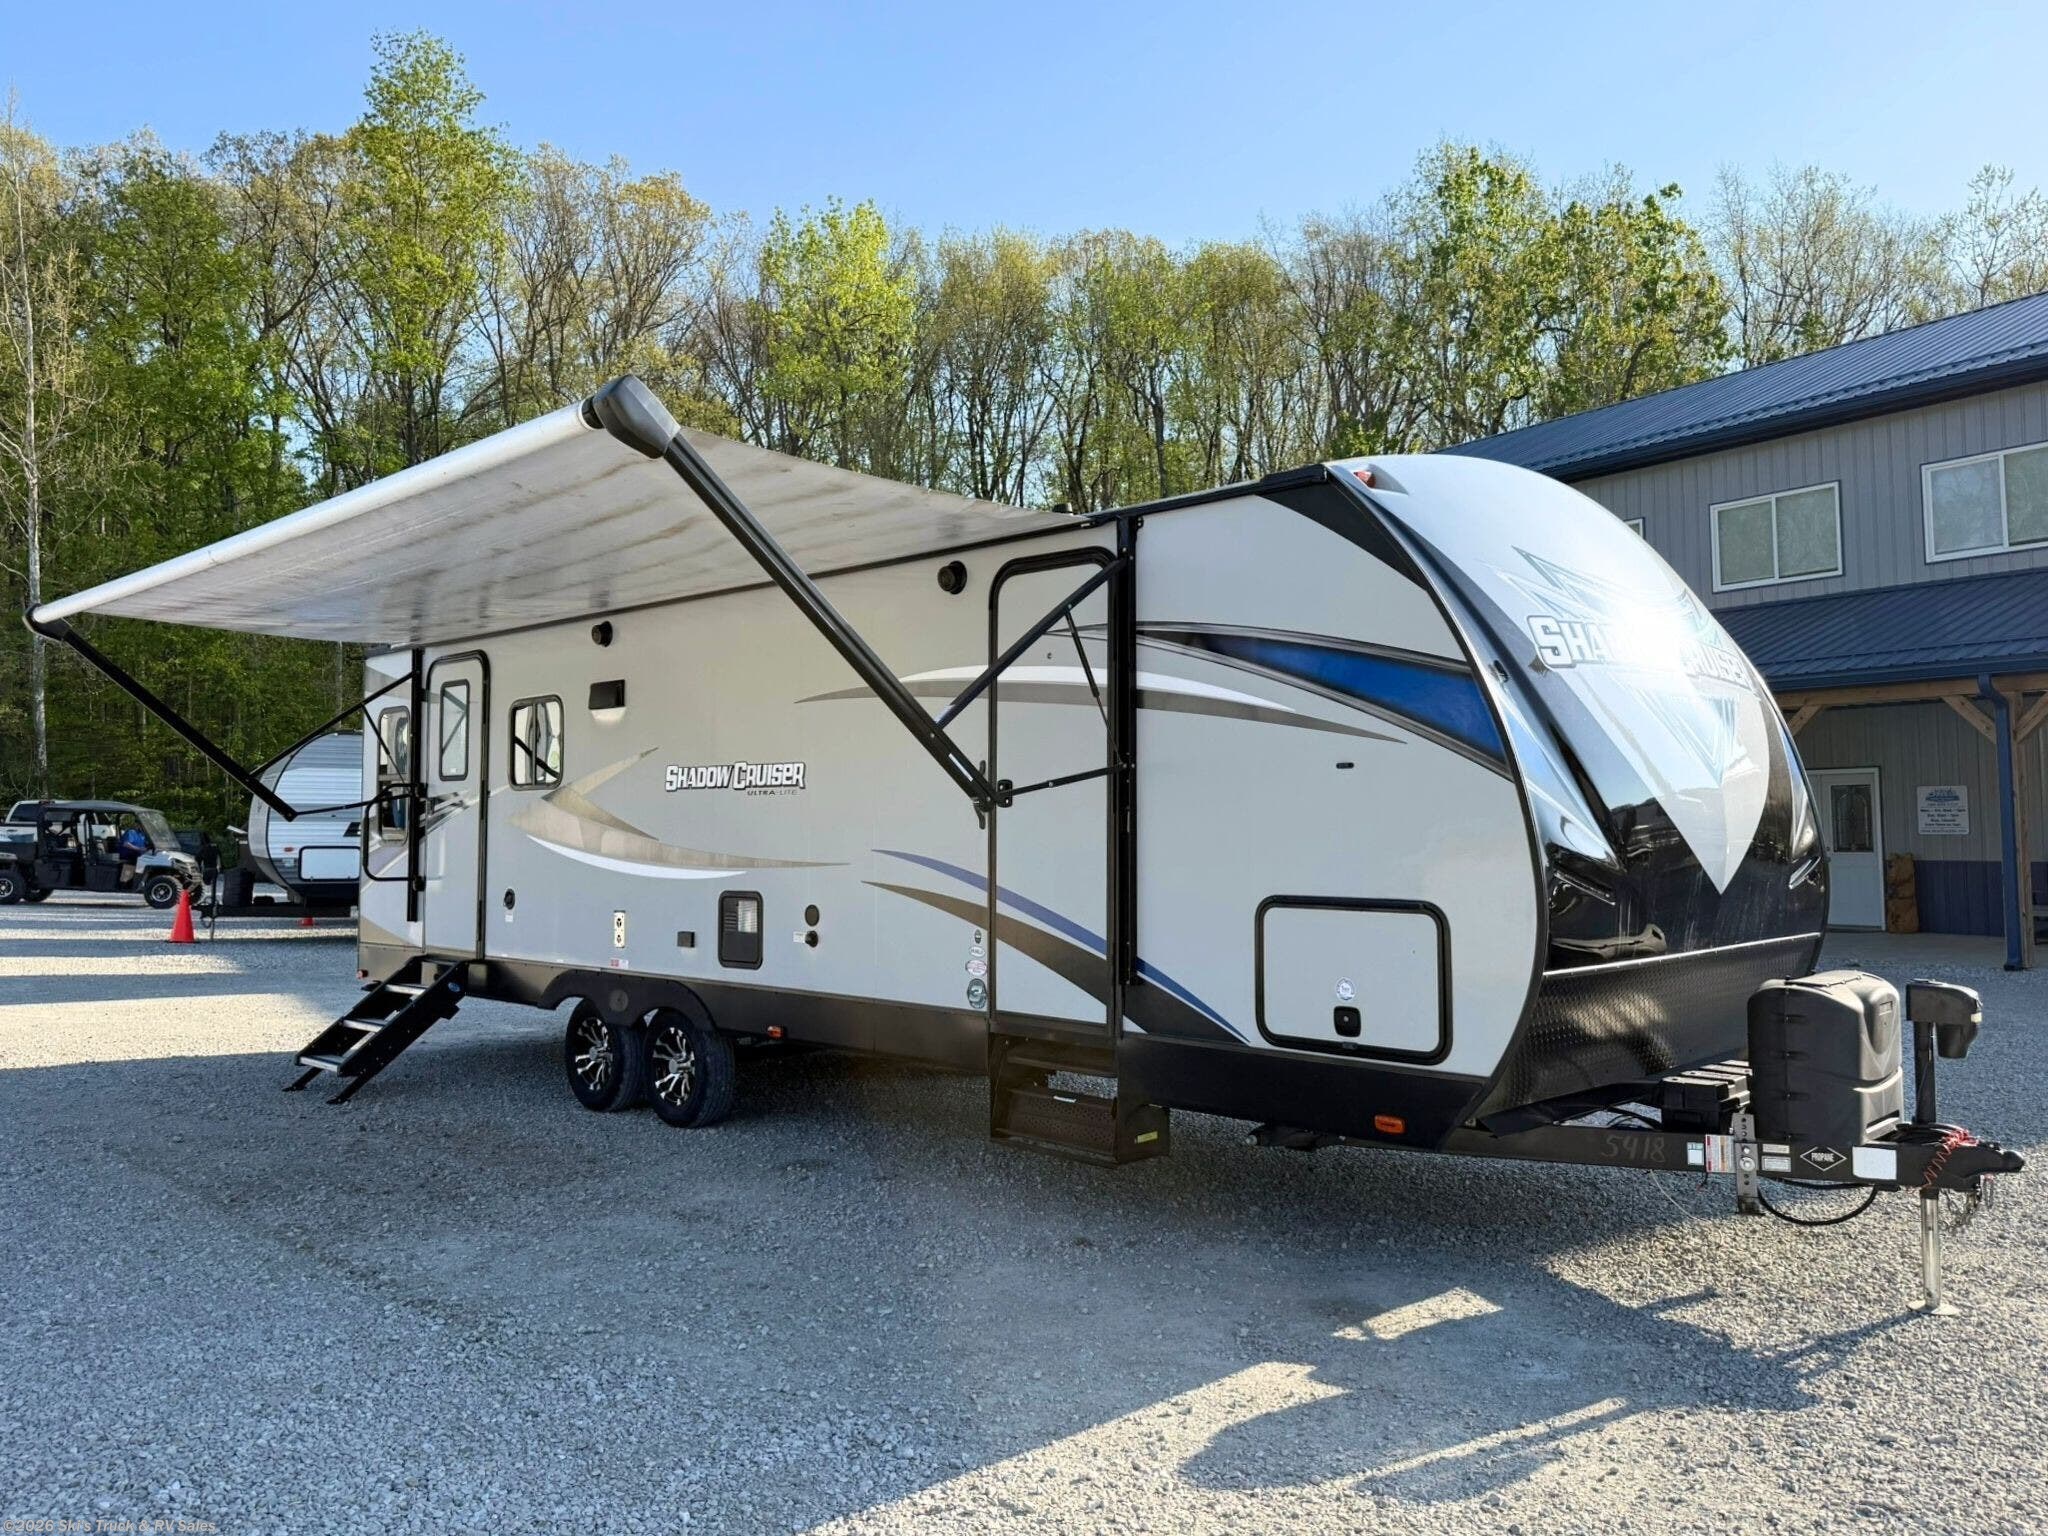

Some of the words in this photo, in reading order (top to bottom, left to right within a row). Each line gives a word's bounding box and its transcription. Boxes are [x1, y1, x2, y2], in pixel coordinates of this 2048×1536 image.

[665, 764, 734, 792] SHADOW
[732, 760, 806, 791] CRUISER
[1602, 1135, 1667, 1163] 5418
[1811, 1152, 1834, 1163] PROPANE
